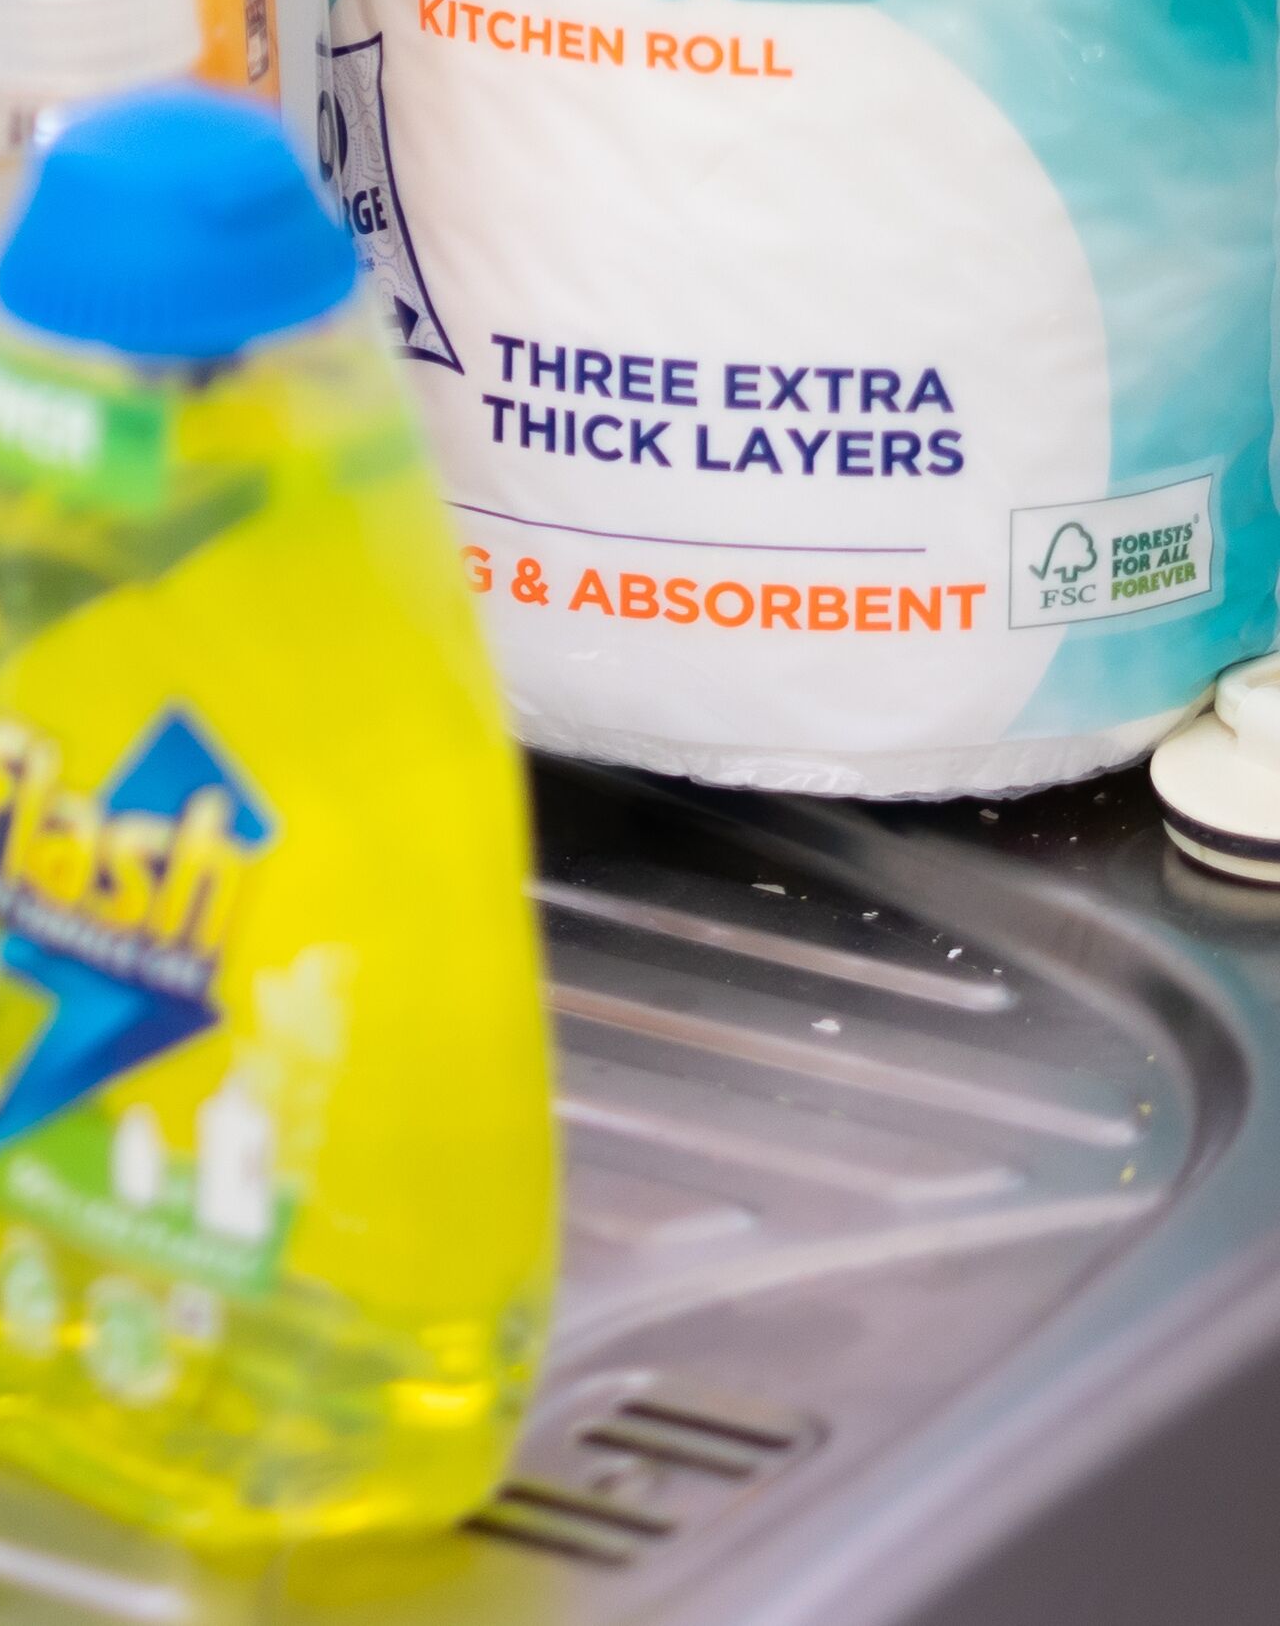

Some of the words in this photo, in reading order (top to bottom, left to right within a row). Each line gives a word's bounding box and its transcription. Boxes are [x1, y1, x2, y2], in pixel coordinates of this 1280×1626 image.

[644, 31, 794, 79] ROLL
[490, 332, 698, 414] THREE
[723, 362, 954, 416] EXTRA
[482, 394, 671, 468] THICK
[695, 421, 966, 477] LAYERS
[1110, 561, 1197, 601] FOREVER
[1111, 555, 1151, 578] FOR
[1157, 544, 1189, 568] ALL
[511, 556, 553, 606] &
[569, 566, 987, 633] ABSORBENT
[1040, 584, 1097, 610] FSC
